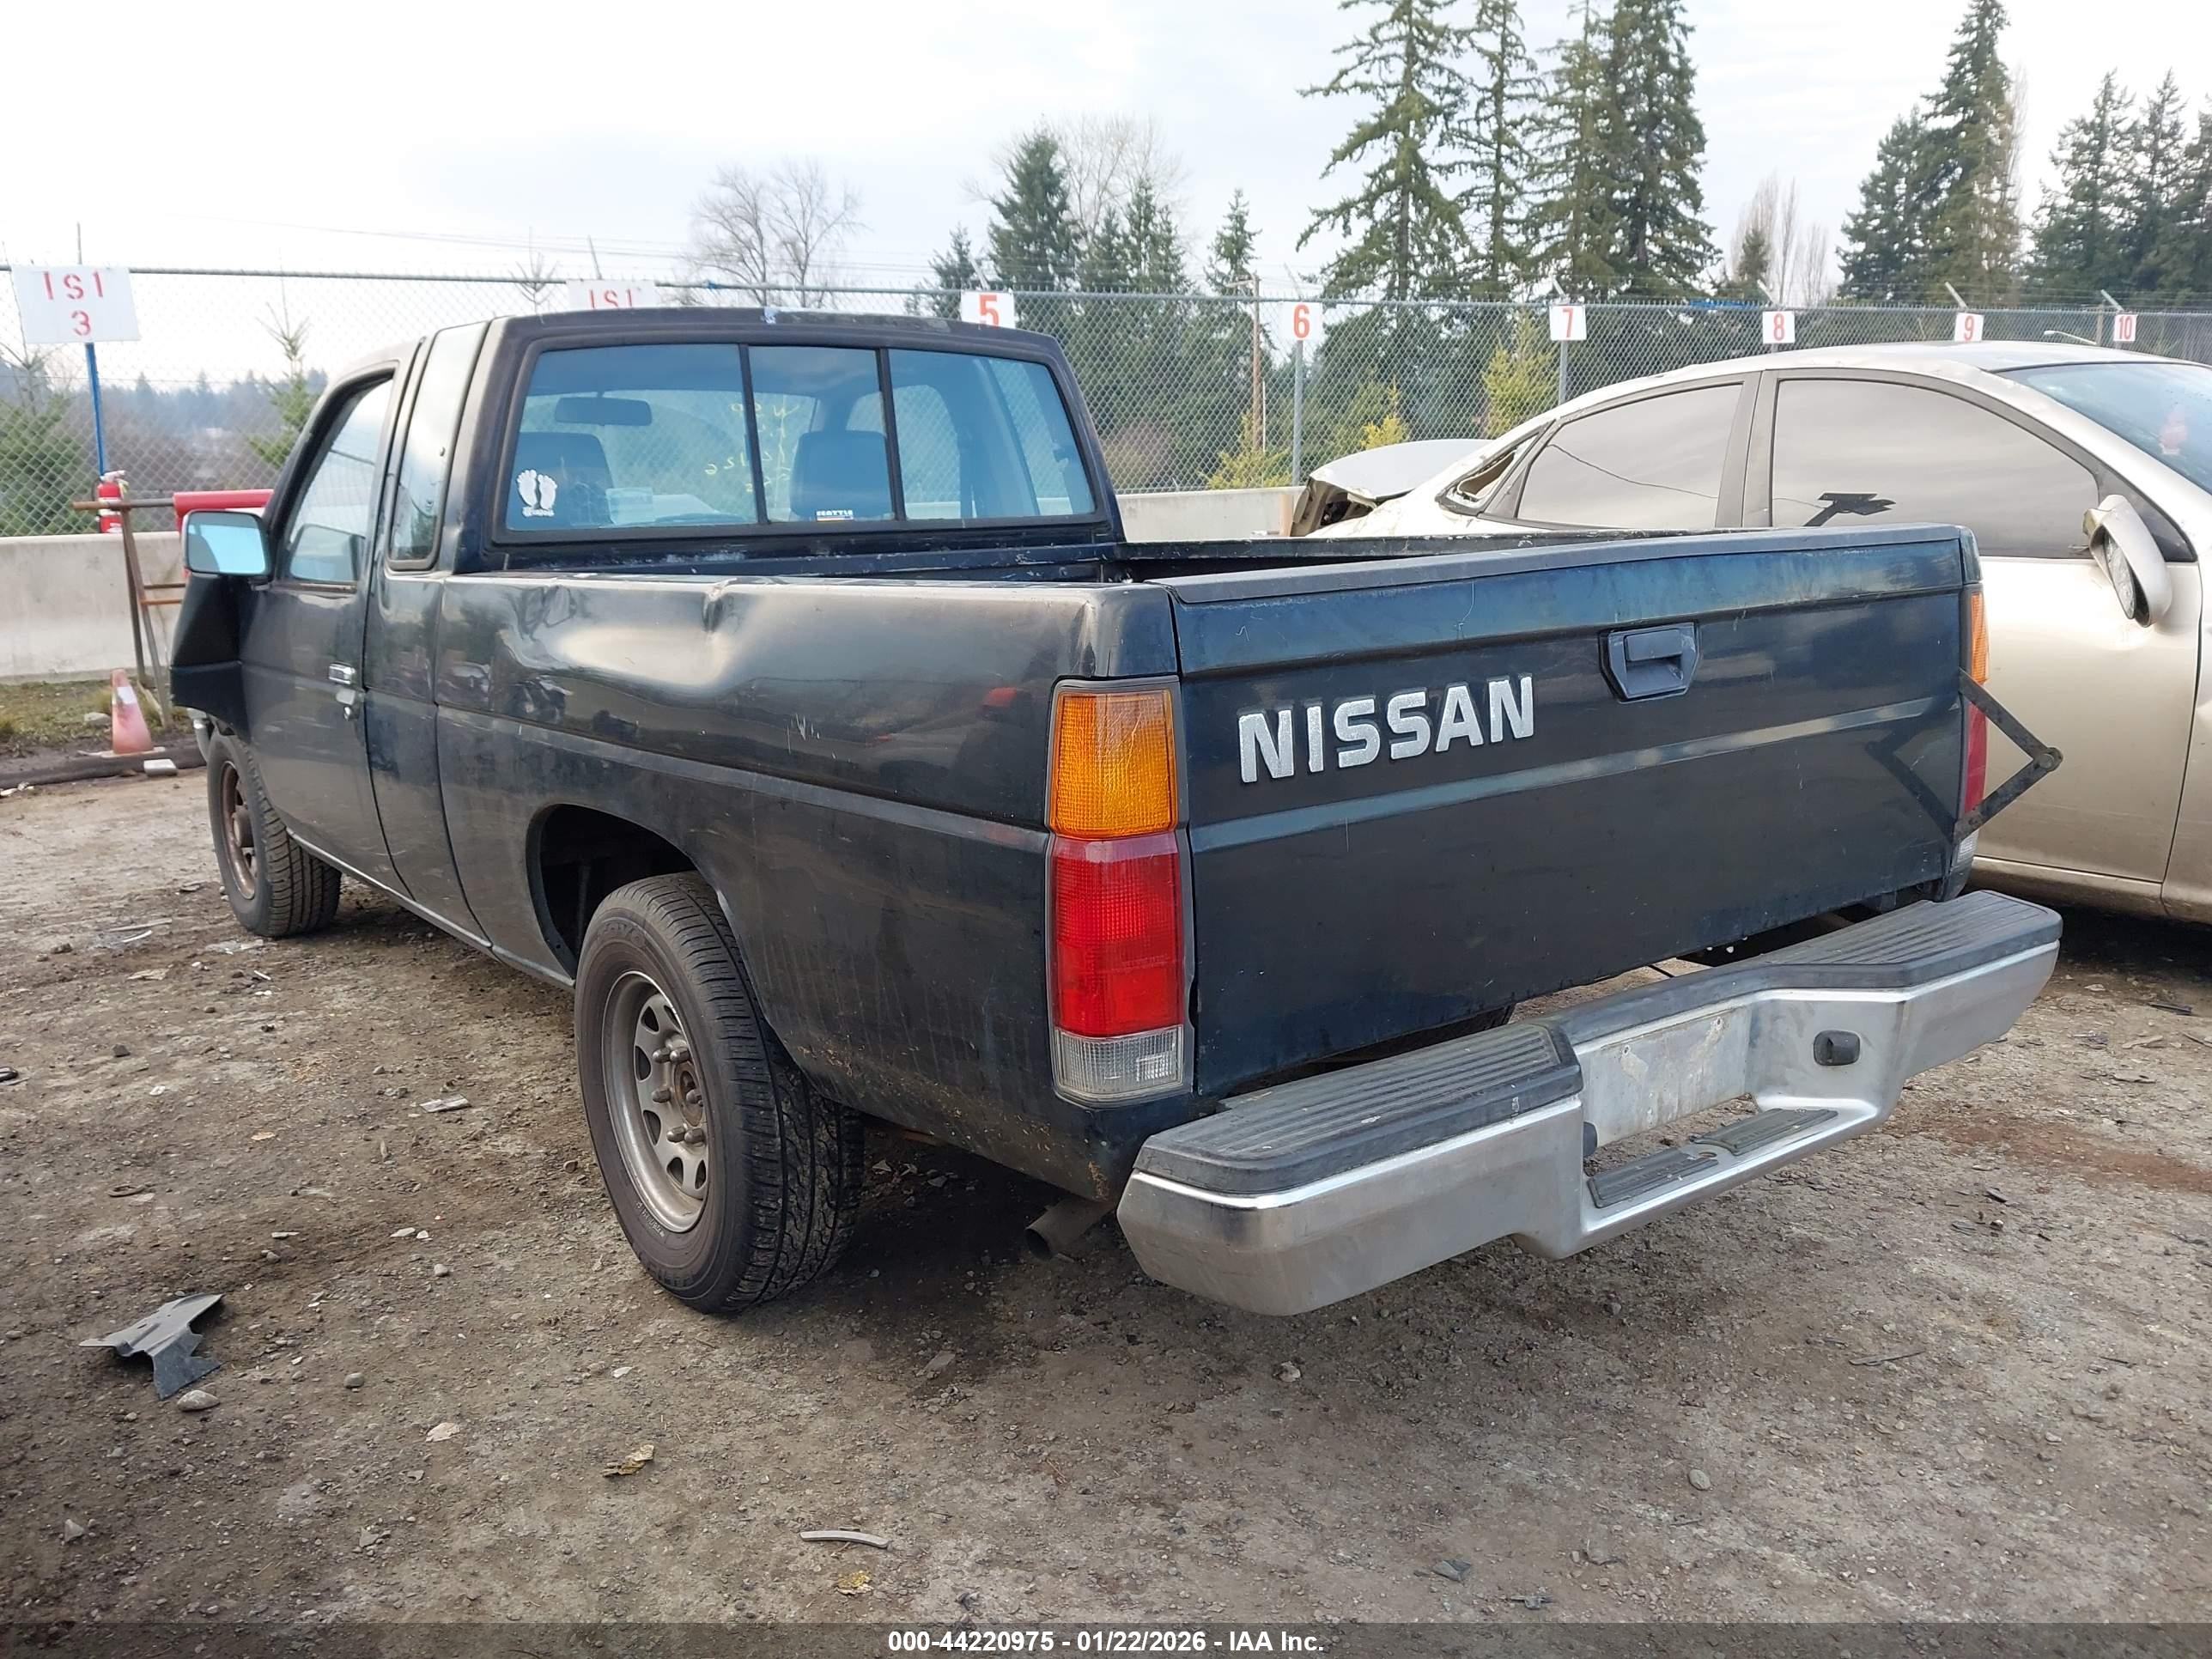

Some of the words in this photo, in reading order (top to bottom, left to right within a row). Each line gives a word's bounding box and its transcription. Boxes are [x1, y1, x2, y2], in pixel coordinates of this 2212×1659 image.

[71, 310, 91, 336] 3
[980, 295, 999, 327] 5
[1294, 304, 1310, 338] 6
[1563, 307, 1573, 337] 7
[1773, 313, 1784, 341] 8
[1964, 315, 1974, 341] 9
[2119, 316, 2132, 340] 10
[1237, 674, 1534, 783] NISSAN
